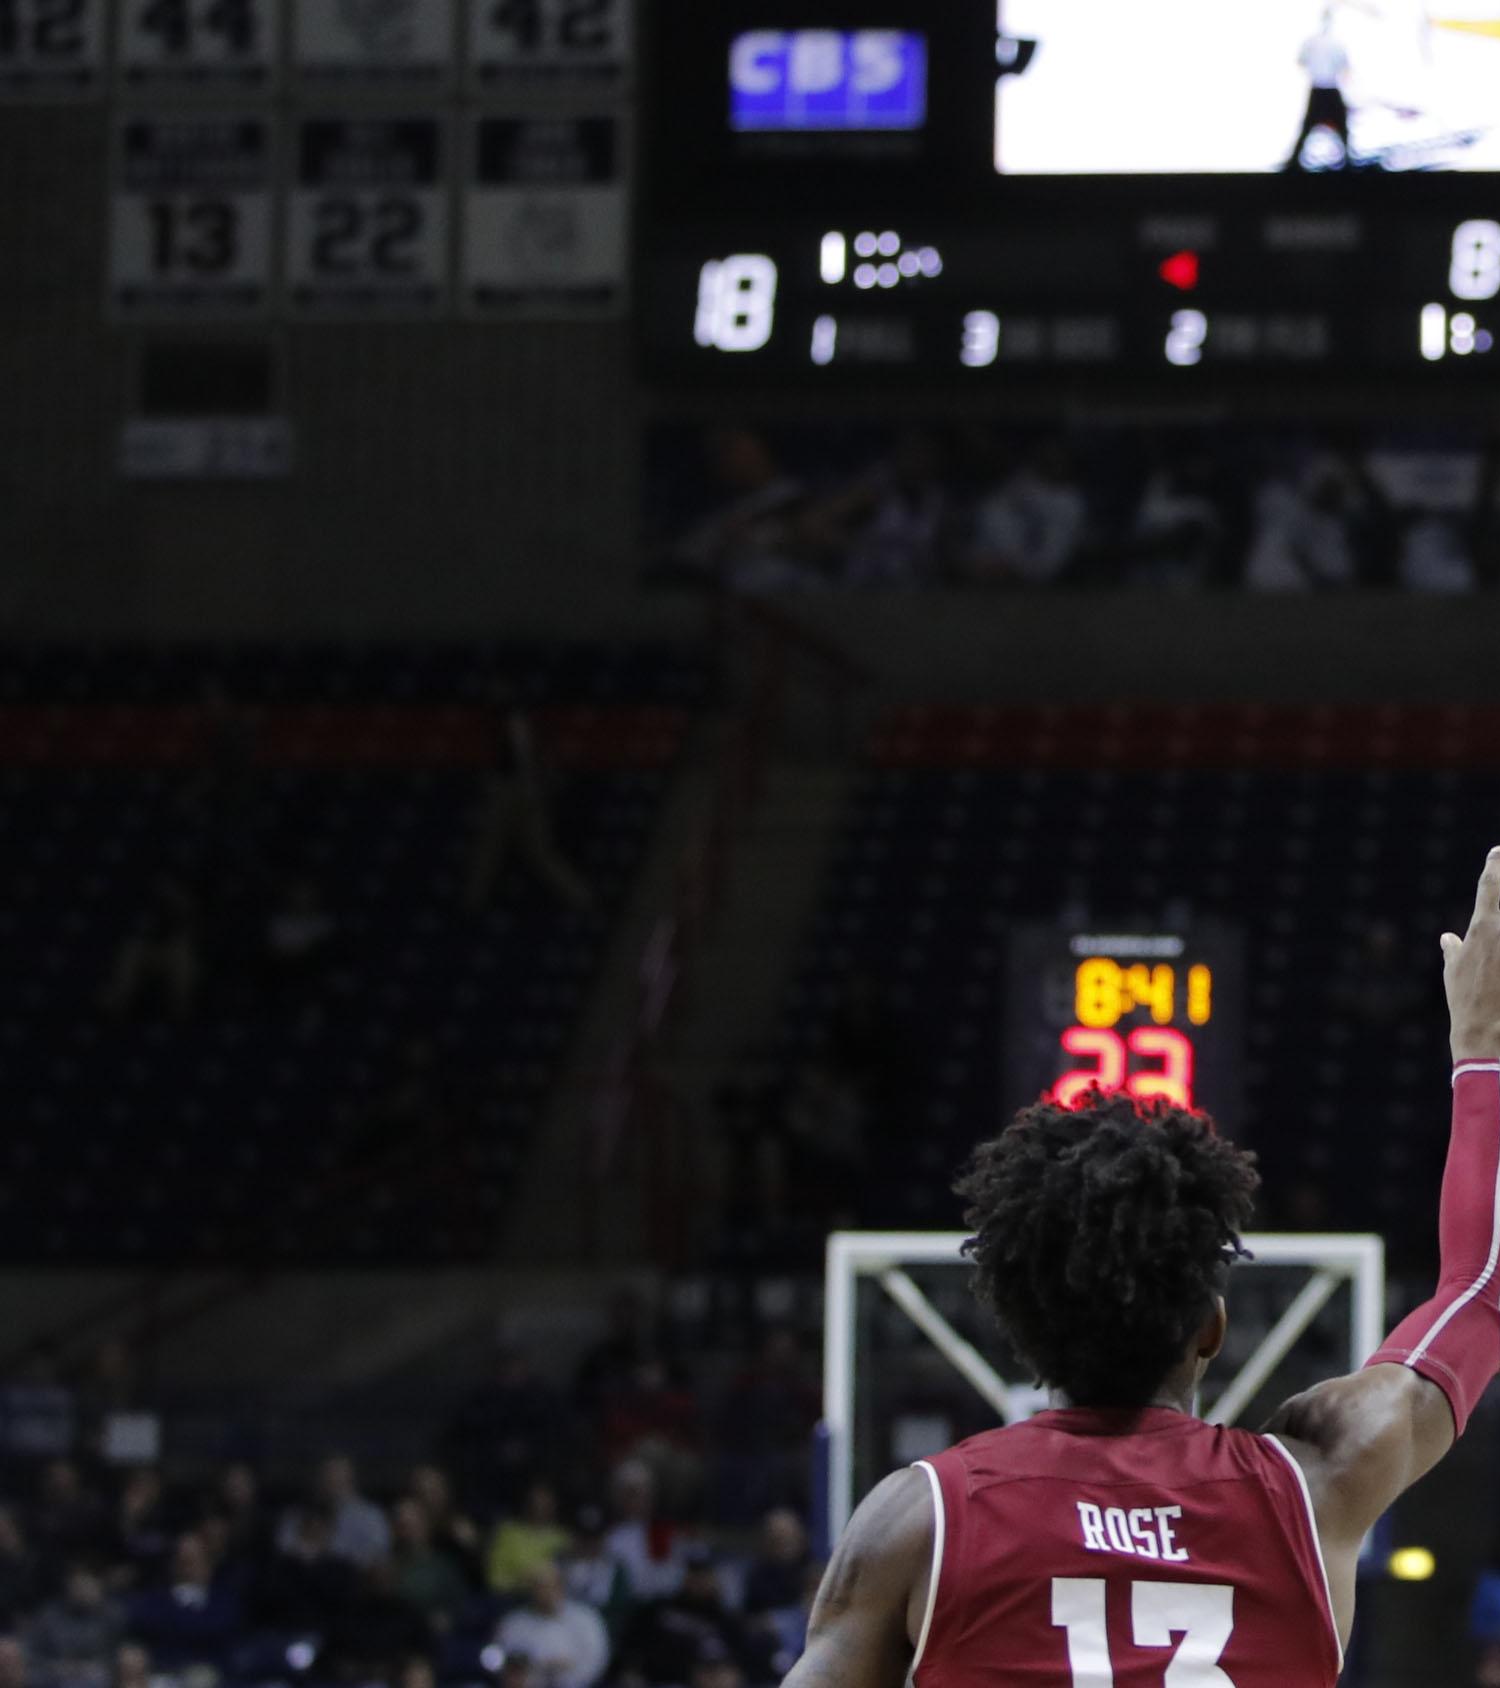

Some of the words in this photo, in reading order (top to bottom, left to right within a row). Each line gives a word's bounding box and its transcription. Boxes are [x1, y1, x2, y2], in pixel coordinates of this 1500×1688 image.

[138, 0, 253, 53] 44
[491, 0, 611, 51] 42
[729, 28, 903, 95] CBS
[148, 202, 236, 272] 13
[314, 200, 423, 273] 22
[694, 253, 777, 351] 18
[959, 309, 1000, 367] 3
[1164, 308, 1208, 366] 2
[1075, 957, 1212, 1026] 8:41
[1076, 1501, 1189, 1562] ROSE
[1052, 1577, 1237, 1688] 13
